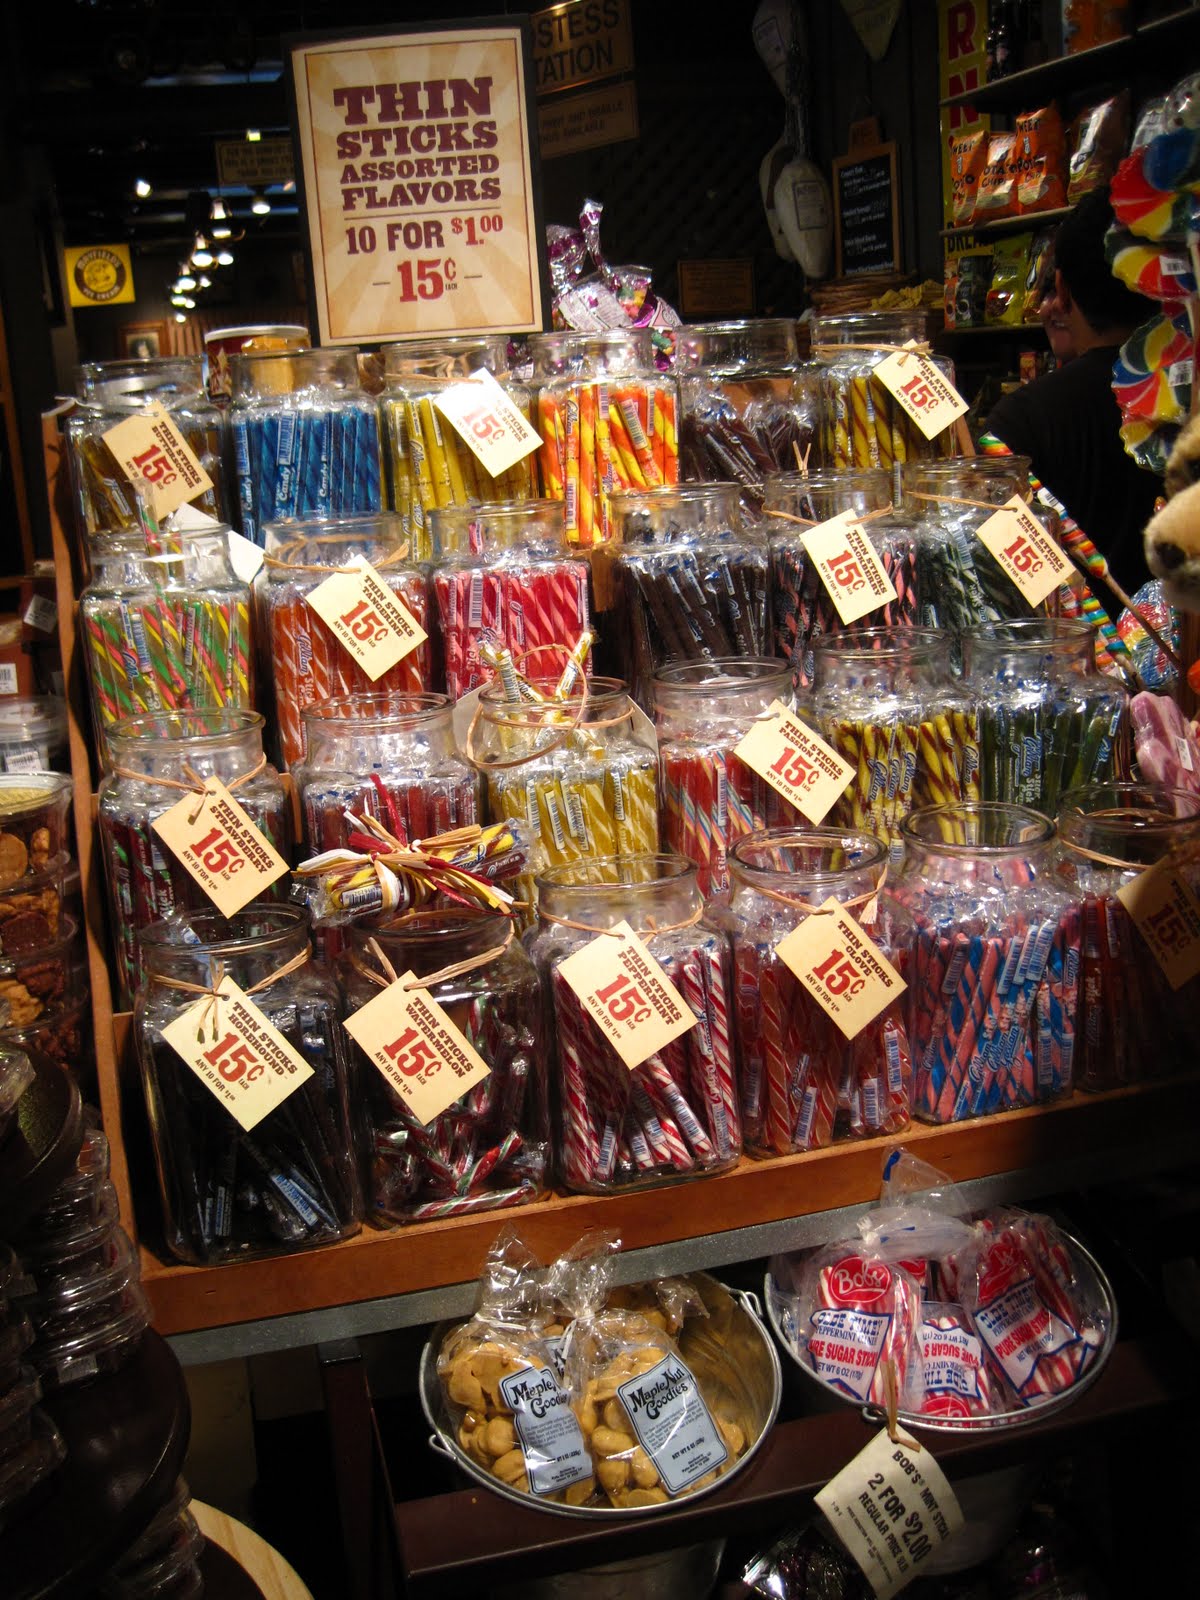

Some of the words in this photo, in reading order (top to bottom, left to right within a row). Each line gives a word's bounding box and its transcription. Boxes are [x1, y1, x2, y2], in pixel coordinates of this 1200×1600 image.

[537, 0, 620, 48] STESS
[531, 38, 613, 85] TATION
[333, 77, 493, 126] THIN
[336, 121, 498, 160] STICKS
[340, 154, 500, 184] ASSORTED
[341, 177, 501, 211] FLAVORS
[345, 225, 377, 255] 10
[387, 220, 445, 251] FOR
[397, 257, 457, 303] 15¢
[900, 375, 940, 410] 15¢
[917, 357, 936, 379] THIN
[934, 378, 959, 409] STICKS
[920, 370, 946, 401] BANANA
[131, 443, 179, 487] 15¢
[151, 426, 195, 489] BUTTERSCOTCH
[158, 421, 179, 448] THIN
[176, 448, 202, 484] STICKS
[280, 466, 291, 501] Candy
[845, 533, 881, 597] BLACKBERRY
[850, 529, 869, 557] THIN
[865, 557, 888, 594] STICKS
[1003, 534, 1045, 574] 15¢
[1015, 518, 1029, 534] SOUR
[1028, 533, 1045, 554] GREEN
[1044, 554, 1060, 573] APPLE
[1020, 514, 1040, 538] THIN
[1038, 537, 1065, 570] STICKS
[825, 549, 867, 592] 15¢
[333, 620, 343, 631] ANY
[339, 598, 391, 644] 15¢
[361, 586, 404, 637] TANGERINE
[363, 575, 386, 602] THIN
[384, 601, 415, 638] STICKS
[770, 745, 822, 790] 15¢
[779, 727, 814, 758] PASSION
[813, 757, 839, 781] FRUIT
[783, 720, 810, 745] THIN
[810, 743, 844, 776] STICKS
[766, 770, 777, 781] ANY
[189, 826, 247, 876] 15¢
[209, 805, 268, 875] STRAWBERRY
[217, 799, 243, 830] THIN
[240, 829, 275, 870] STICKS
[182, 850, 194, 863] ANY
[191, 862, 200, 870] 10
[197, 868, 209, 881] FOR
[812, 948, 868, 998] 15¢
[836, 920, 863, 950] THIN
[860, 949, 894, 988] STICKS
[845, 945, 872, 977] CLOVE
[594, 972, 654, 1025] 15¢
[618, 951, 675, 1027] PEPPERMINT
[625, 946, 651, 978] THIN
[648, 977, 683, 1022] STICKS
[805, 973, 817, 986] ANY
[814, 985, 822, 993] 10
[820, 991, 832, 1004] FOR
[411, 997, 440, 1030] THIN
[437, 1029, 474, 1073] STICKS
[587, 995, 599, 1008] ANY
[596, 1008, 604, 1016] 10
[602, 1015, 613, 1029] FOR
[203, 1029, 267, 1086] 15¢
[238, 1078, 250, 1090] EACH
[228, 1013, 285, 1076] HOREHOUND
[231, 1001, 261, 1033] THIN
[258, 1032, 298, 1075] STICKS
[382, 1025, 444, 1080] 15¢
[415, 1073, 427, 1086] EACH
[405, 1004, 465, 1078] WATERMELON
[195, 1058, 208, 1072] ANY
[206, 1071, 214, 1079] 10
[212, 1078, 225, 1092] FOR
[374, 1051, 387, 1065] ANY
[385, 1064, 394, 1073] 10
[391, 1071, 404, 1085] FOR
[825, 1342, 855, 1363] SUGAR
[933, 1343, 959, 1358] SUGAR
[994, 1334, 1017, 1359] PURE
[510, 1378, 554, 1405] Maple
[627, 1381, 665, 1413] Maple
[661, 1367, 685, 1390] Nut
[645, 1382, 688, 1420] Goodies
[858, 1491, 890, 1536] REGULAR
[866, 1472, 886, 1491] 2
[877, 1485, 908, 1524] FOR
[901, 1510, 934, 1564] $2.00
[920, 1487, 940, 1514] MINT
